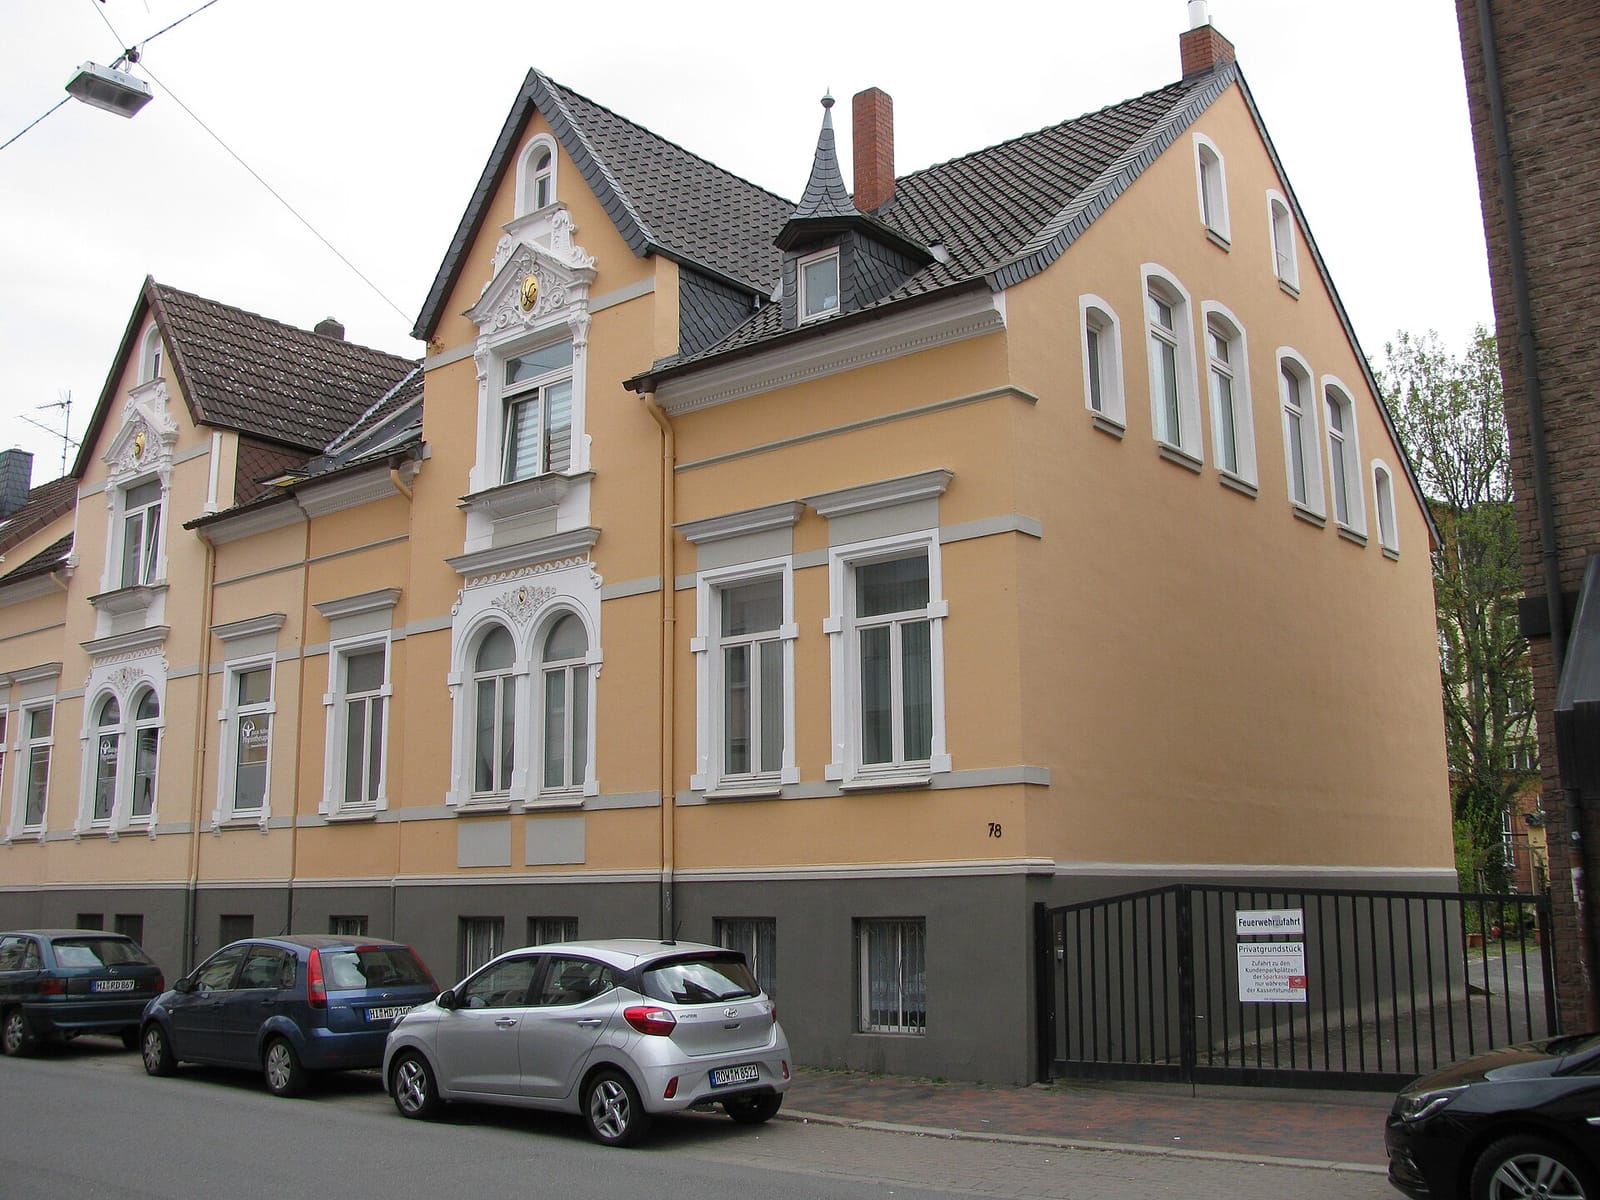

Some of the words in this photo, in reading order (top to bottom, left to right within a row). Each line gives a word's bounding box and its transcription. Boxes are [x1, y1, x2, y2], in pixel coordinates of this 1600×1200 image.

[988, 822, 1001, 838] 78
[1239, 917, 1300, 927] Feuerwehrzufahrt
[1239, 945, 1302, 954] Privatgrundstück
[96, 981, 106, 990] HI
[370, 1009, 378, 1018] HI
[715, 1070, 729, 1082] ROW
